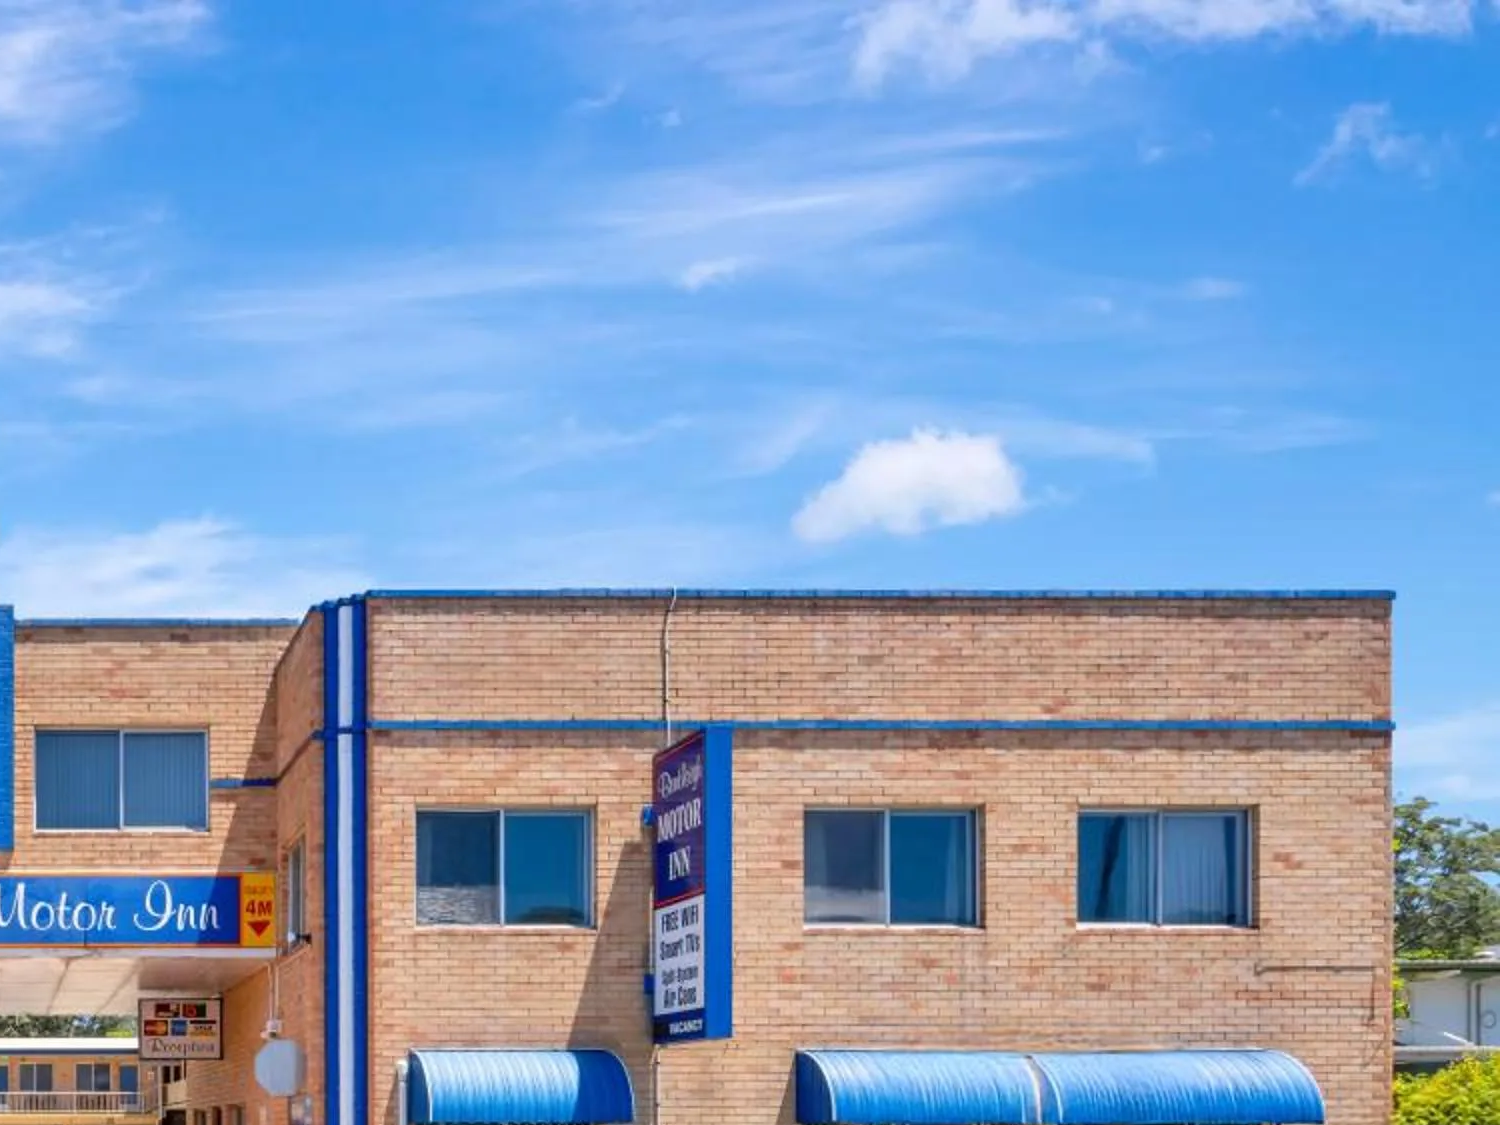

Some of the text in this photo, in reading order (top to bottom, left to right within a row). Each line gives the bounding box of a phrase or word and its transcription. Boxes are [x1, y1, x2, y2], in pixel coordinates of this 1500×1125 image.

[657, 797, 702, 843] MOTOR
[668, 845, 691, 881] INN
[133, 879, 220, 932] Inn
[245, 899, 273, 917] 4M
[661, 909, 679, 933] FREE
